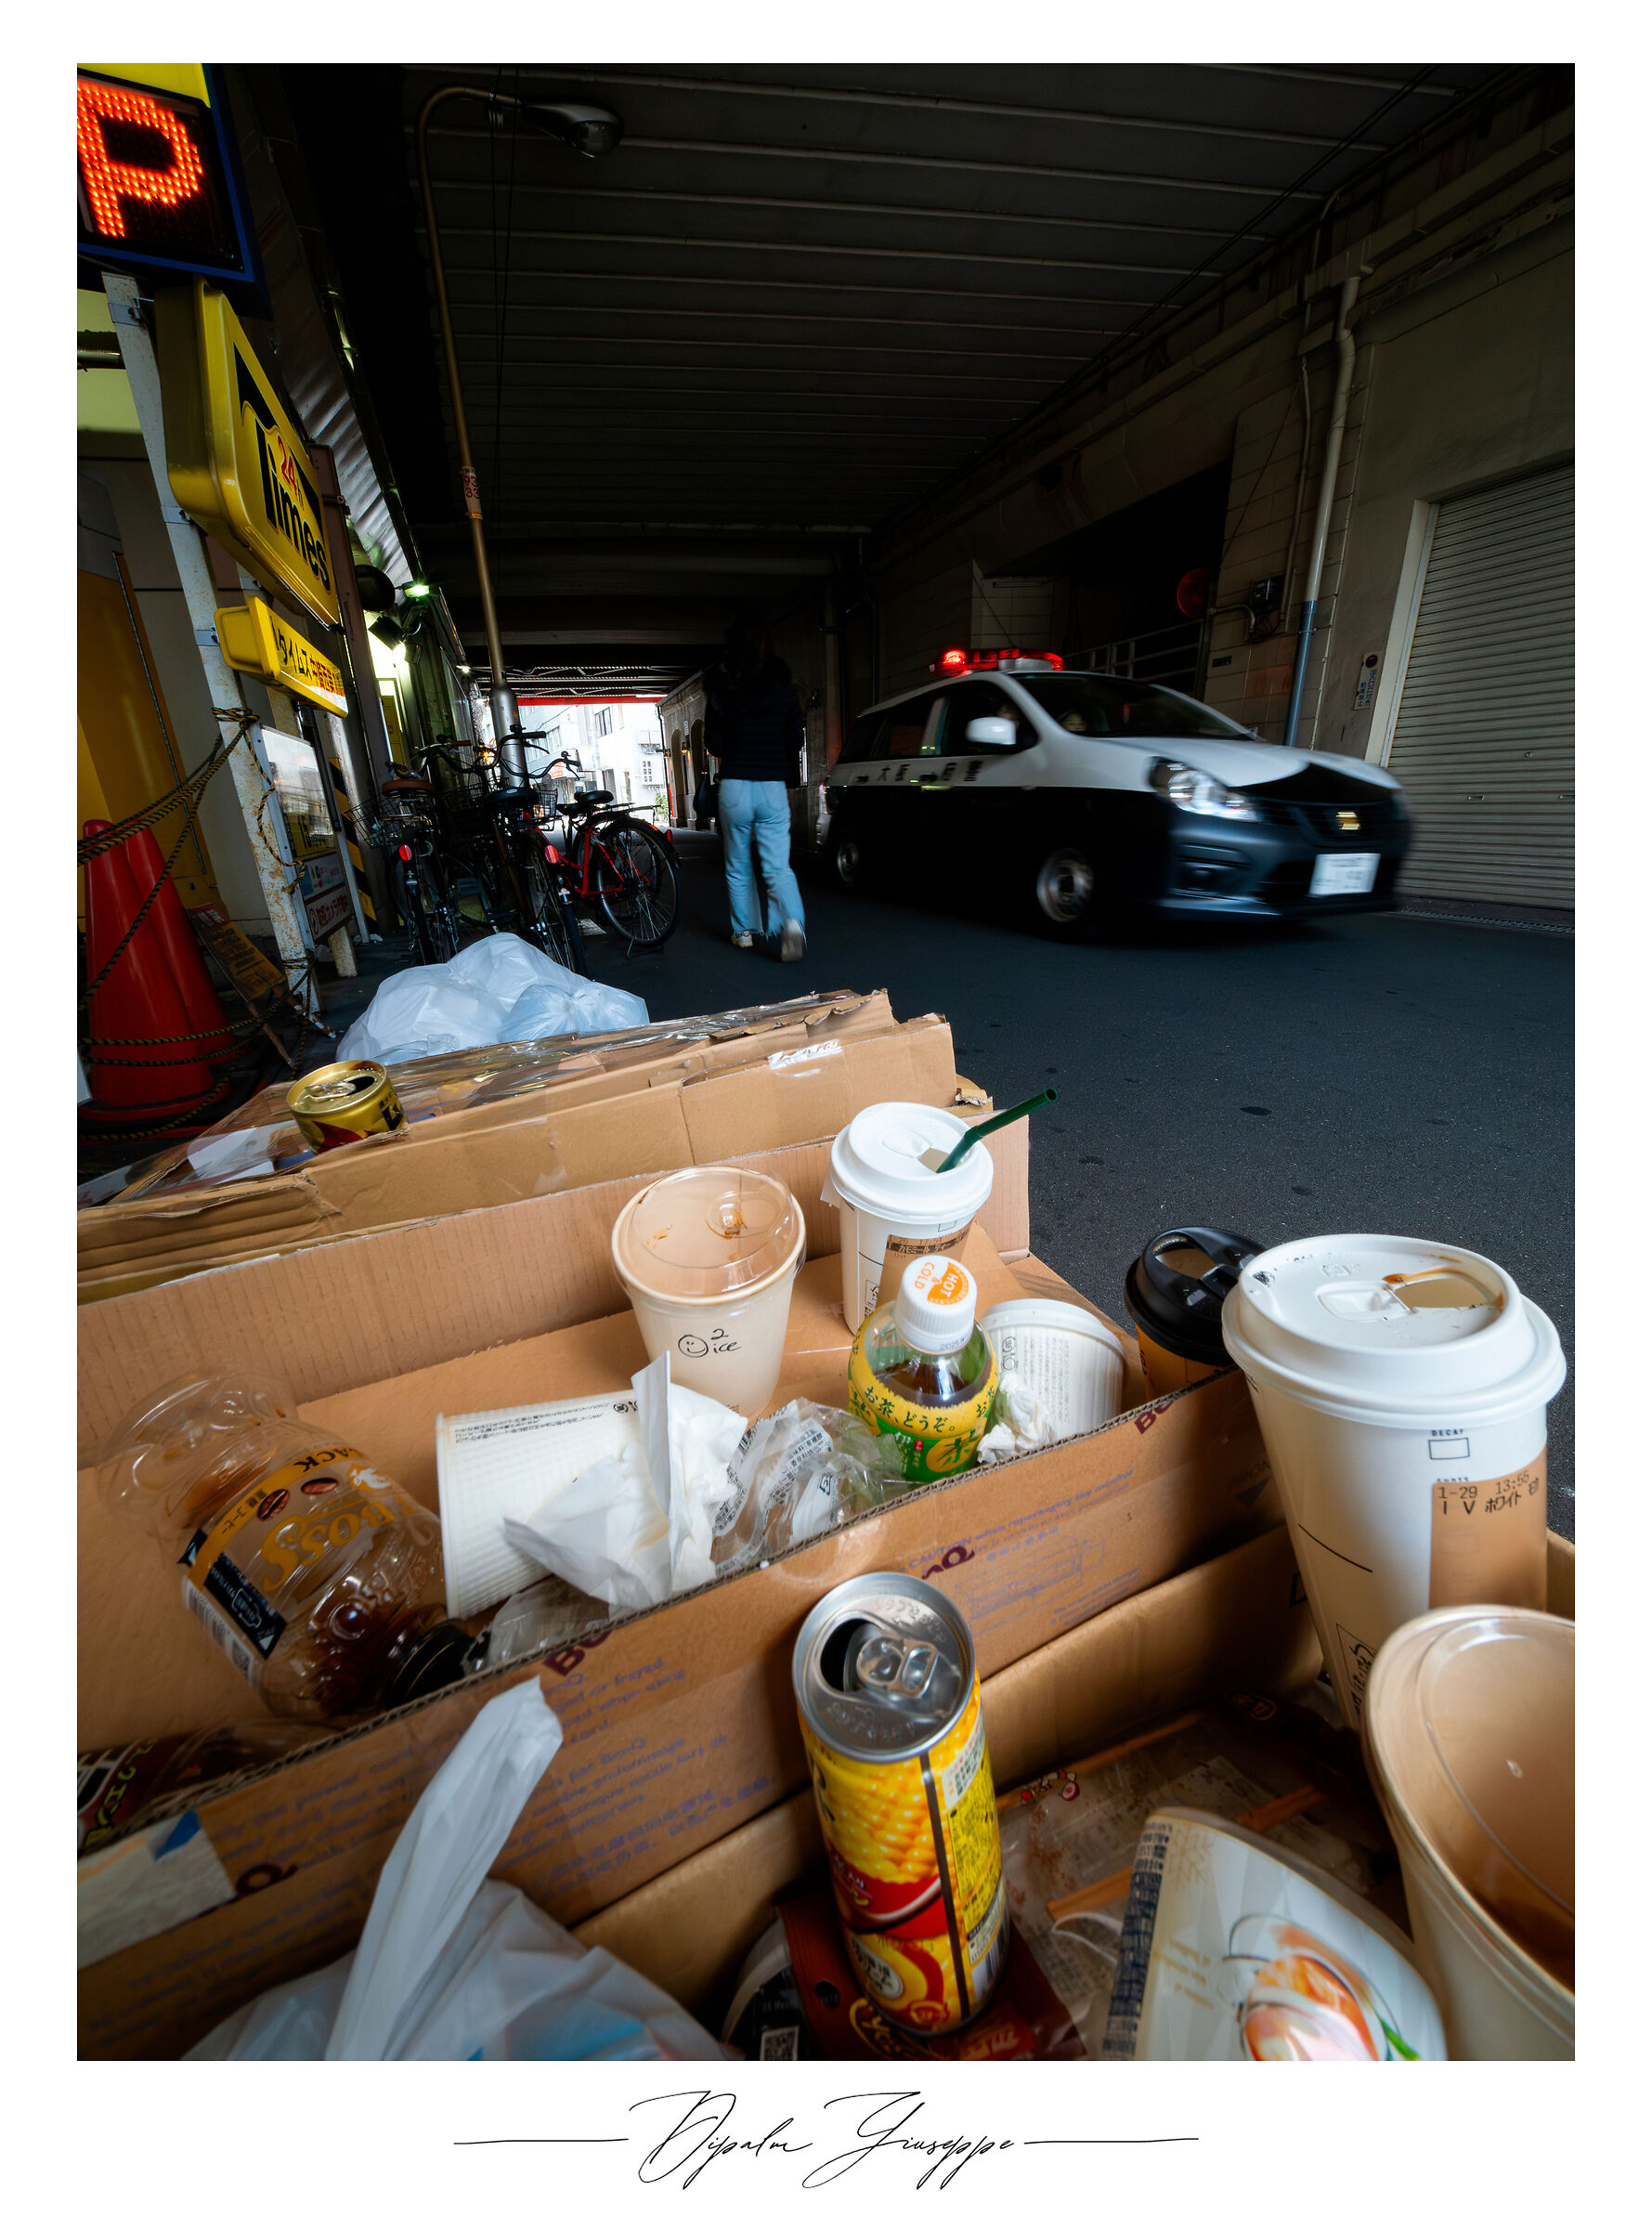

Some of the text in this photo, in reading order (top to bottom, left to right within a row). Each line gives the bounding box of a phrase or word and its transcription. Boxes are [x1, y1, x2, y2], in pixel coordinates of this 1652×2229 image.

[77, 78, 202, 237] P
[914, 1260, 936, 1290] COLD
[939, 1272, 959, 1298] HOT
[713, 1336, 744, 1355] ice
[864, 1385, 956, 1433] お茶、どうぞ。
[1437, 1485, 1478, 1500] 1-29
[1485, 1492, 1523, 1514] ホワイト
[263, 1500, 396, 1596] BOSS
